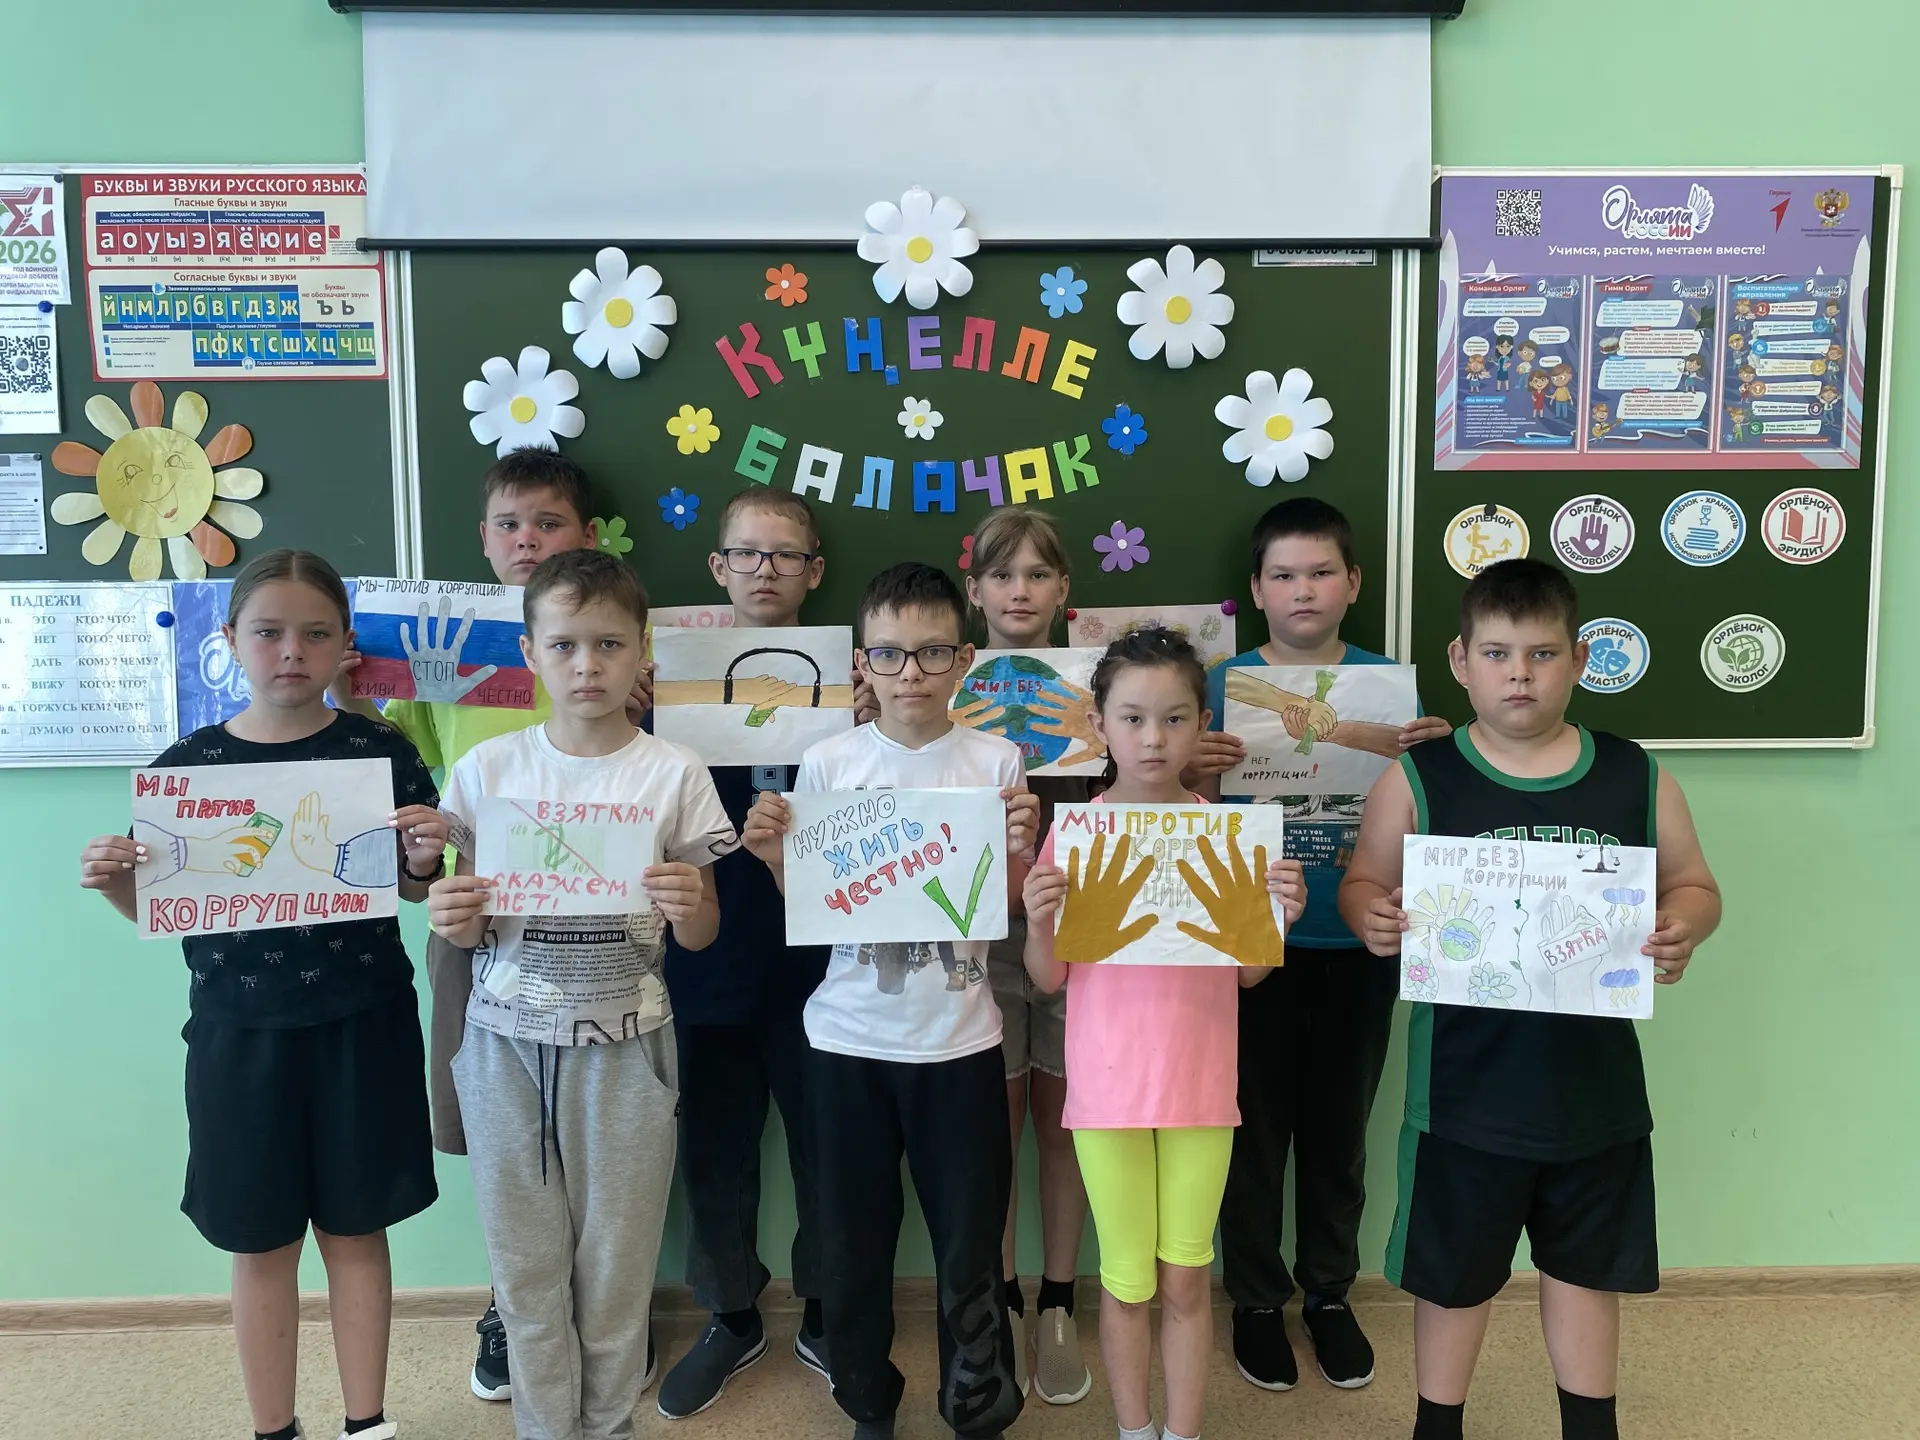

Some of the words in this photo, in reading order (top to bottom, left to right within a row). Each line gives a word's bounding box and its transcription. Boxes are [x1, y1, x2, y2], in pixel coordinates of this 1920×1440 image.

[94, 180, 148, 194] БУКВЫ
[153, 180, 164, 193] И
[168, 179, 221, 193] ЗВУКИ
[226, 179, 307, 193] РУССКОГО
[312, 179, 367, 193] ЯЗЫКА
[174, 198, 214, 208] Гласные
[217, 198, 249, 208] буквы
[260, 199, 287, 208] звуки
[1605, 187, 1693, 232] Орлята
[1548, 245, 1600, 257] Учимся,
[1603, 246, 1653, 257] растем,
[1656, 246, 1711, 256] мечтаем
[1716, 245, 1766, 255] вместе!
[173, 272, 226, 282] Согласные
[228, 272, 261, 282] буквы
[270, 274, 297, 282] звуки
[734, 424, 1100, 513] БАЛАЧАК
[1779, 494, 1833, 513] ОРЛЁНОК
[1668, 497, 1699, 525] ОРЛЁНОК
[1705, 497, 1739, 530] ХРАНИТЕЛЬ
[1560, 540, 1622, 566] ДОБРОВОЛЕЦ
[1669, 532, 1712, 560] ИСТОРИЧЕСКОЙ
[1713, 538, 1736, 558] ПАМЯТИ
[1778, 543, 1824, 557] ЭРУДИТ
[11, 595, 82, 608] ПАДЕЖИ
[33, 616, 56, 625] ЭТО
[75, 615, 105, 625] КТО?
[107, 614, 136, 624] ЧТО?
[34, 635, 57, 644] НЕТ
[77, 634, 114, 644] КОГО?
[116, 634, 152, 643] ЧЕГО?
[1581, 625, 1635, 642] ОРЛЁНОК
[1713, 622, 1766, 645] ОРЛЁНОК
[32, 658, 62, 668] ДАТЬ
[78, 657, 118, 667] КОМУ?
[120, 656, 158, 666] ЧЕМУ?
[412, 661, 455, 682] СТОП
[1585, 672, 1631, 686] МАСТЕР
[1726, 664, 1770, 684] ЭКОЛОГ
[32, 681, 65, 690] ВИЖУ
[79, 679, 116, 689] КОГО?
[119, 679, 147, 689] ЧТО?
[353, 682, 396, 696] ЖИВИ
[971, 680, 1012, 693] МИР
[1018, 680, 1043, 693] БЕЗ
[478, 689, 532, 705] ЧЕСТНО
[23, 703, 77, 712] ГОРЖУСЬ
[81, 703, 112, 712] КЕМ?
[29, 726, 74, 736] ДУМАЮ
[82, 725, 91, 734] О
[93, 725, 124, 734] КОМ?
[127, 725, 136, 734] О
[1251, 757, 1271, 766] НЕТ
[137, 774, 189, 798] МЫ
[176, 798, 256, 819] ПРОТИВ
[537, 801, 654, 824] ВЗЯТКАМ
[793, 794, 896, 859] НУЖНО
[1060, 808, 1115, 835] МЫ
[1126, 811, 1243, 836] ПРОТИВ
[823, 818, 924, 879] ЖИТЬ
[1424, 846, 1469, 867] МИР
[1476, 846, 1520, 868] БЕЗ
[1463, 868, 1568, 891] КОРРУПЦИИ
[150, 892, 369, 933] КОРРУПЦИИ
[526, 931, 545, 940] NEW
[547, 934, 580, 942] WORLD
[582, 932, 623, 942] SHENSHI
[1544, 927, 1608, 967] ВЗЯТКА
